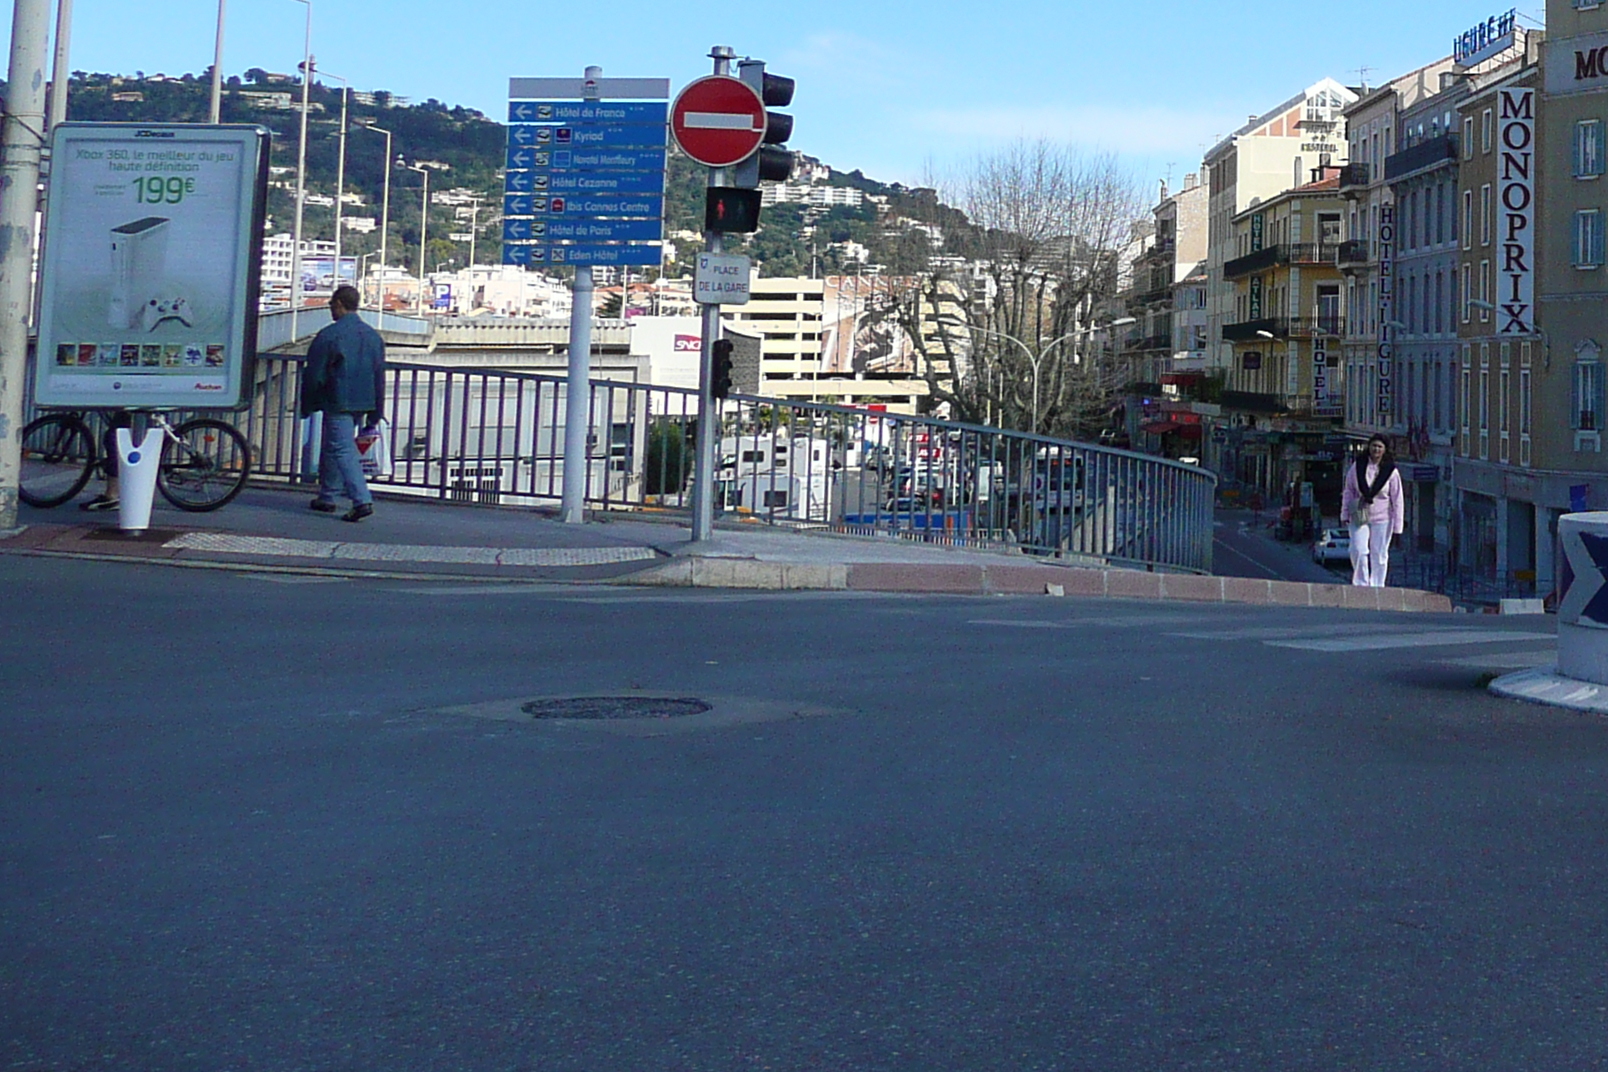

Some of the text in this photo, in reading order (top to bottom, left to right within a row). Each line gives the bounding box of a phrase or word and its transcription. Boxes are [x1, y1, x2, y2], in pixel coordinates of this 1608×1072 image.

[556, 107, 625, 118] Hôtel de France
[575, 132, 604, 142] Kyriad
[76, 149, 103, 159] Xbox
[134, 150, 144, 160] le
[148, 151, 195, 160] meilleur
[199, 151, 213, 161] du
[216, 152, 233, 163] jeu
[109, 161, 199, 171] haute définition
[552, 177, 617, 187] Hôtel Cezanne
[133, 177, 195, 204] 199€
[567, 202, 649, 212] Ibis Cannes Centre
[1500, 91, 1533, 333] MONOPRIX
[550, 225, 612, 235] Hôtel de Paris
[1253, 215, 1261, 251] HOTEL
[569, 248, 617, 260] Eden Hôtel
[1381, 208, 1392, 298] HOTEL
[714, 266, 739, 275] PLACE
[699, 282, 747, 293] DE LA GARE
[1314, 339, 1325, 400] HOTEL
